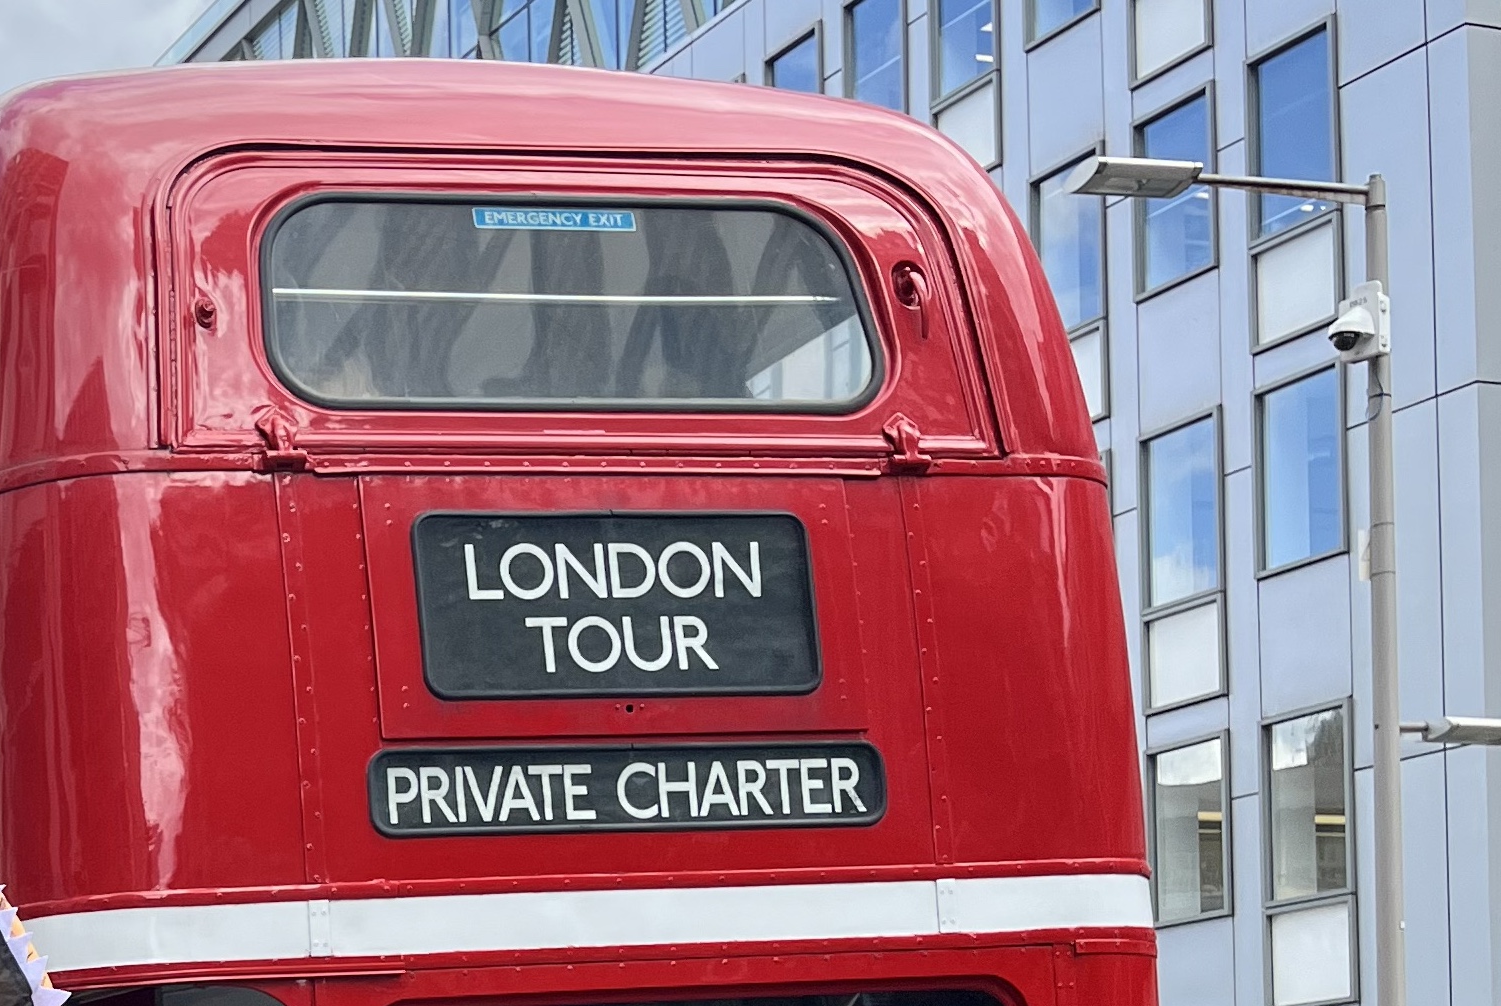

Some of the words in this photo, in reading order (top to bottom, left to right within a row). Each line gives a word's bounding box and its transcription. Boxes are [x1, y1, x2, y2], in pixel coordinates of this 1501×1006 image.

[484, 211, 582, 227] EMERGENCY
[589, 213, 623, 227] EXIT
[463, 541, 762, 600] LONDON
[525, 615, 719, 673] TOUR
[386, 764, 597, 825] PRIVATE
[616, 757, 867, 820] CHARTER
